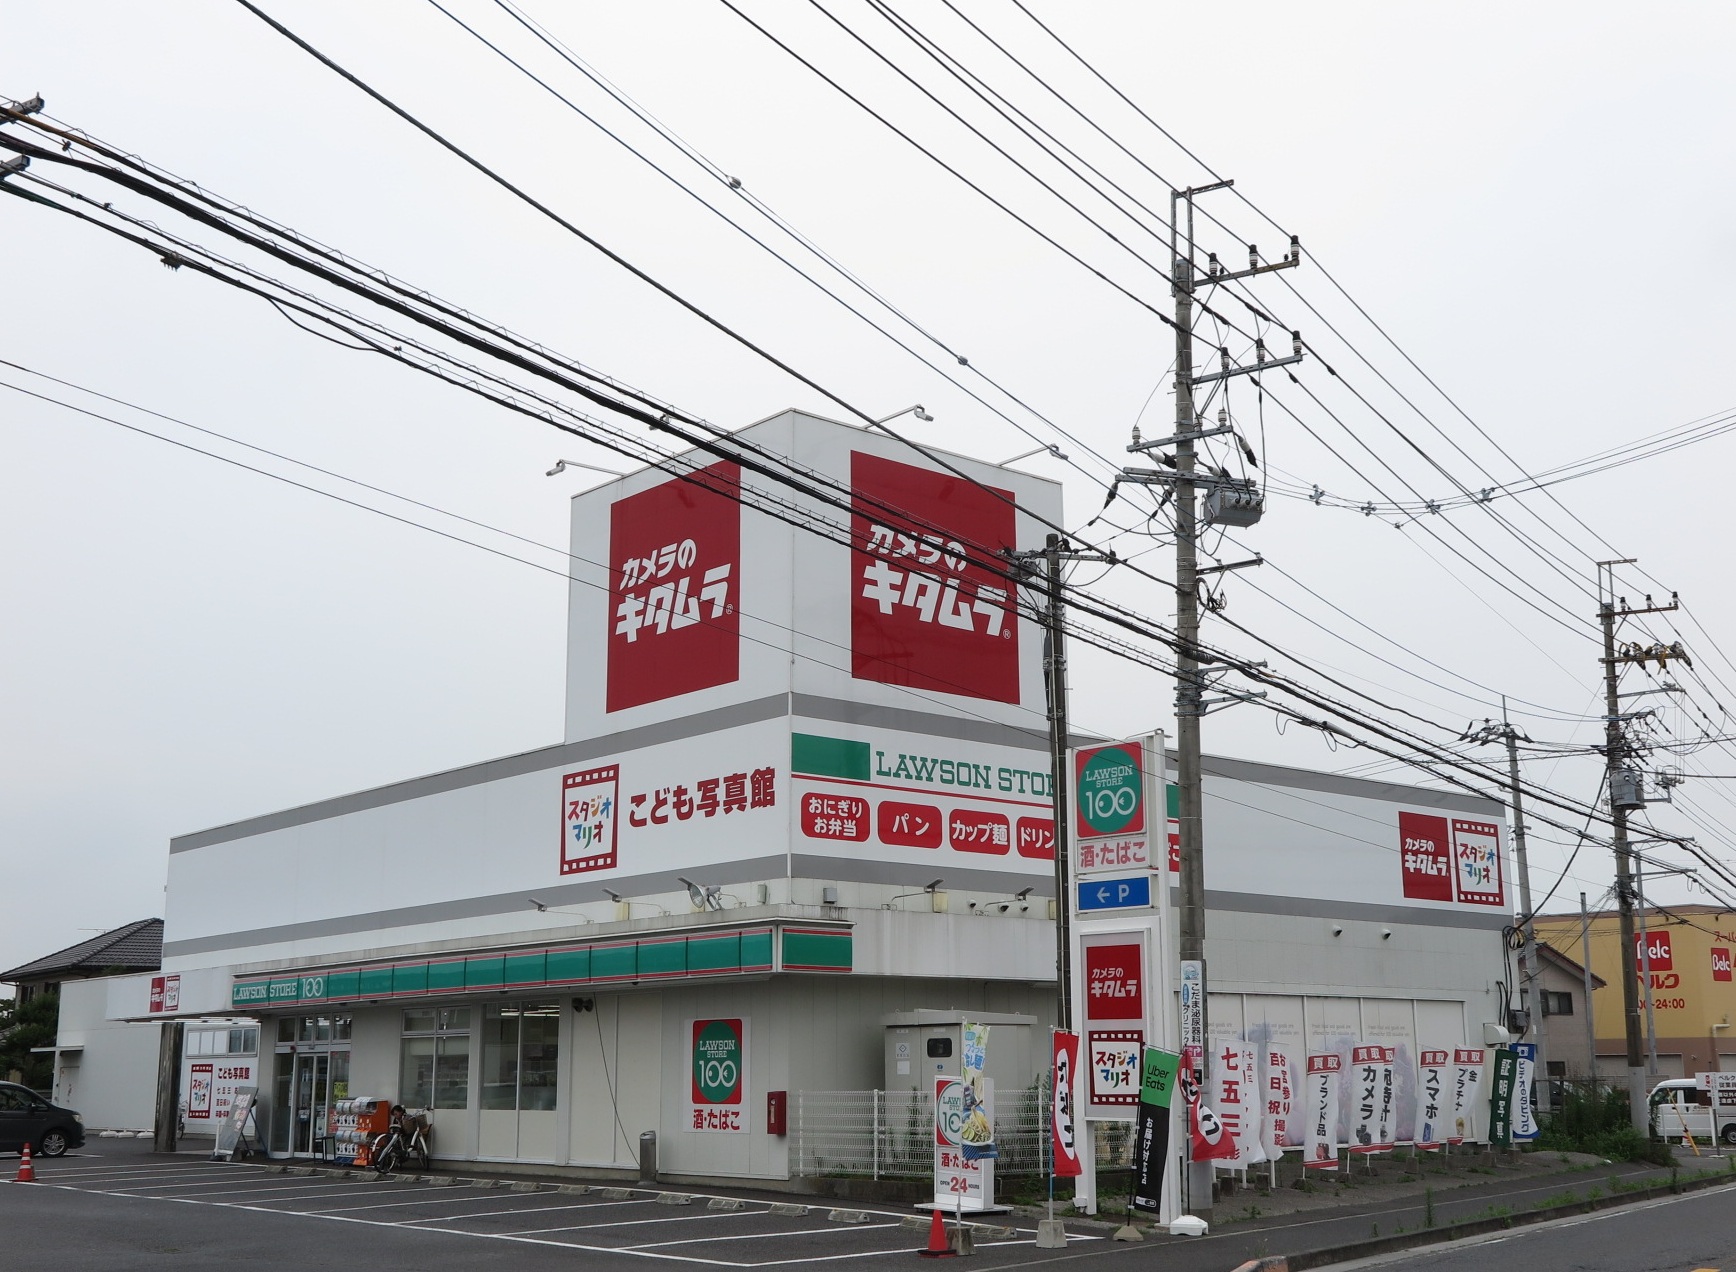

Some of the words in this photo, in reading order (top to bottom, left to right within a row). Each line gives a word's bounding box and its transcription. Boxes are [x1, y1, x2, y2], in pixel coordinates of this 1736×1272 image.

[866, 524, 967, 571] カメラの
[619, 538, 697, 591] カメラの
[615, 563, 732, 643] キタムラ
[862, 559, 1007, 637] キタムラ
[876, 751, 992, 790] LAWSON
[1086, 765, 1134, 782] LAWSON
[1096, 777, 1124, 788] STORE
[629, 766, 775, 828] こども写真館
[808, 796, 863, 818] おにぎり
[1086, 787, 1136, 820] 100
[568, 795, 612, 822] スタジオ
[572, 820, 604, 849] マリオ
[813, 817, 857, 837] お弁当
[892, 814, 930, 836] パン
[952, 820, 1009, 846] カップ麺
[1404, 838, 1435, 852] カメラの
[1459, 843, 1495, 866] スタジオ
[1404, 852, 1448, 876] キタムラ
[1464, 865, 1490, 885] マリオ
[1118, 884, 1130, 903] P
[1092, 967, 1123, 979] カメラの
[1712, 954, 1731, 971] Belc
[233, 985, 267, 1000] LAWSON
[269, 983, 297, 998] STORE
[302, 978, 324, 998] 100
[1091, 979, 1138, 997] キタムラ
[1191, 982, 1202, 1045] こだま泌尿器科
[699, 1040, 736, 1050] LAWSON
[1358, 1048, 1381, 1060] 買取
[1095, 1050, 1137, 1069] スタジオ
[1313, 1056, 1338, 1069] 買取
[1425, 1052, 1445, 1063] 買取
[1460, 1051, 1480, 1063] 買取
[218, 1067, 250, 1079] こども写真館
[699, 1060, 737, 1088] 100
[1101, 1068, 1131, 1088] マリオ
[1147, 1063, 1169, 1079] Uber
[1468, 1070, 1477, 1082] 金
[192, 1079, 209, 1092] スタジオ
[1145, 1077, 1166, 1091] Eats
[1220, 1047, 1241, 1137] 七五三
[1360, 1065, 1377, 1120] カメラ
[1426, 1068, 1440, 1119] スマホ
[1455, 1068, 1469, 1111] プラチナ
[1316, 1074, 1329, 1136] ブランド品
[950, 1176, 968, 1193] 24
